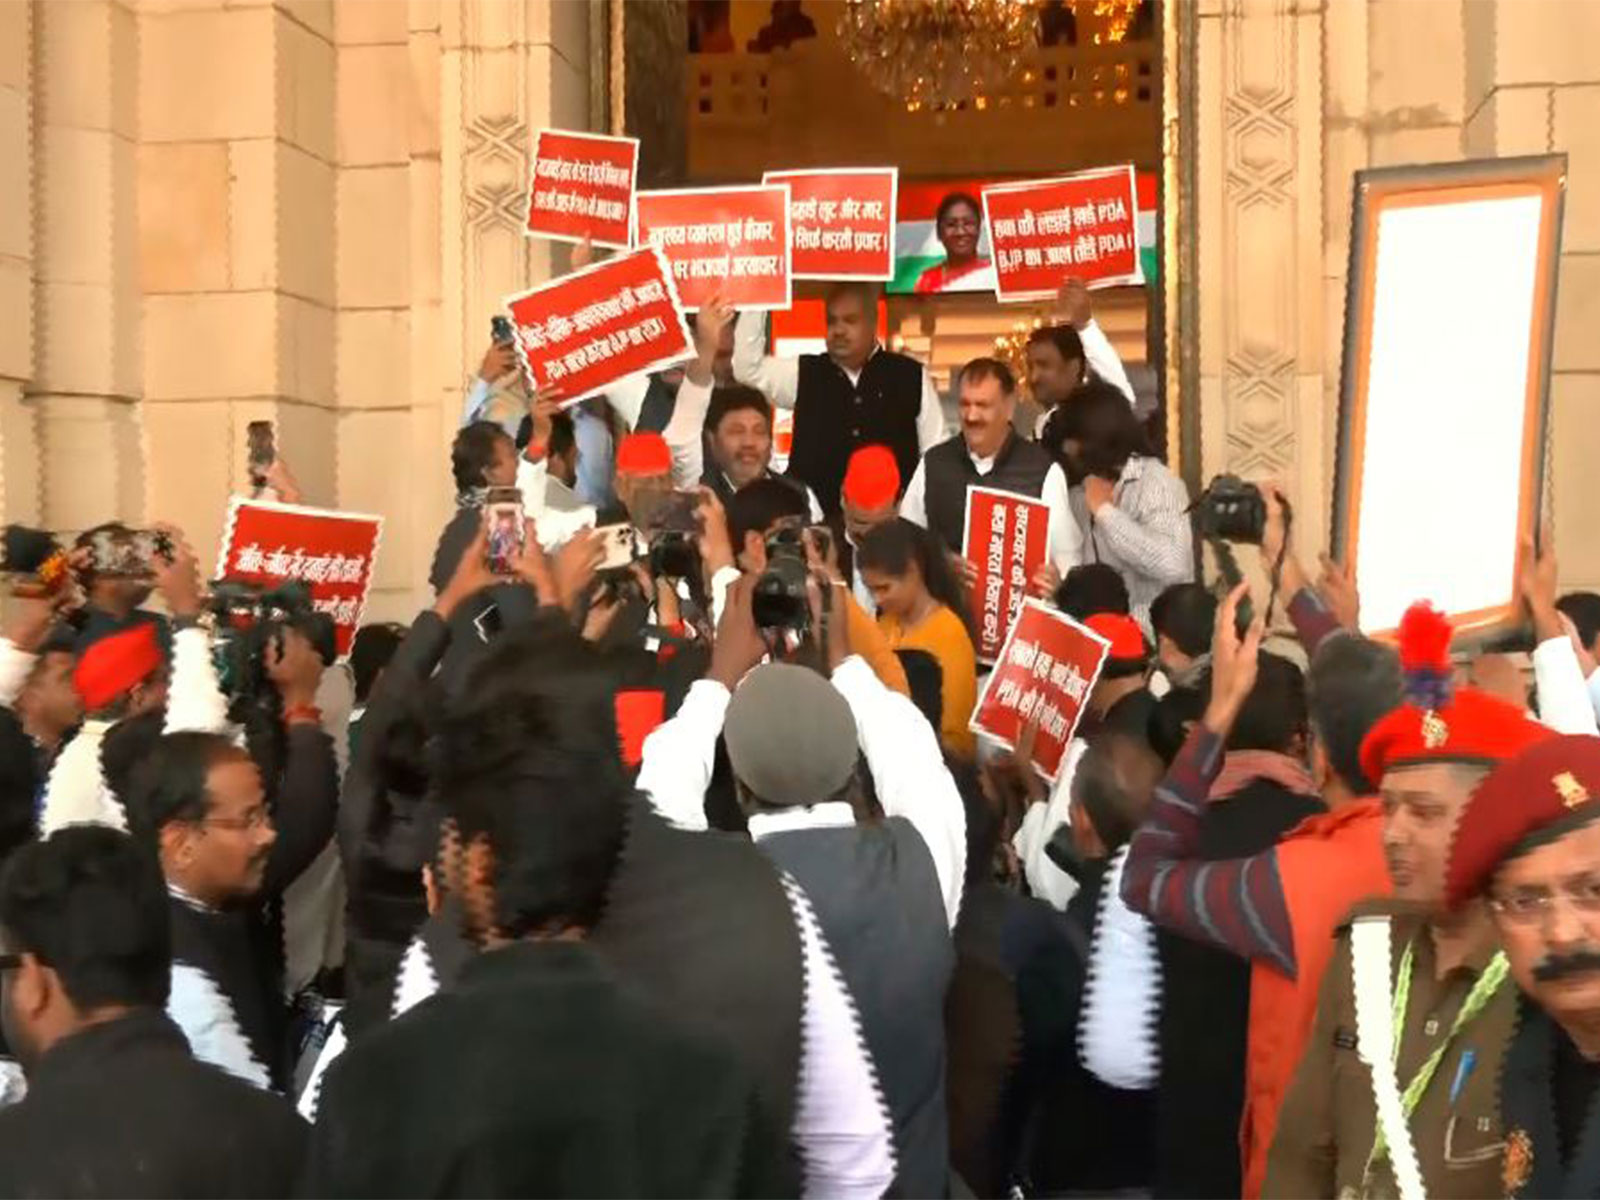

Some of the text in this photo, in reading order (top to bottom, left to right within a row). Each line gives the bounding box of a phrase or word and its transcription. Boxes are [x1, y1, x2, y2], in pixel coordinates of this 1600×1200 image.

[818, 201, 837, 224] लूट
[840, 197, 860, 219] और
[1018, 208, 1035, 236] की
[1098, 198, 1126, 222] PDA
[727, 218, 743, 249] हुई
[822, 227, 852, 251] करती
[998, 249, 1023, 273] BJP
[1024, 247, 1041, 266] का
[1098, 233, 1125, 256] PDA
[987, 533, 1004, 573] भारत
[995, 678, 1021, 709] PDA
